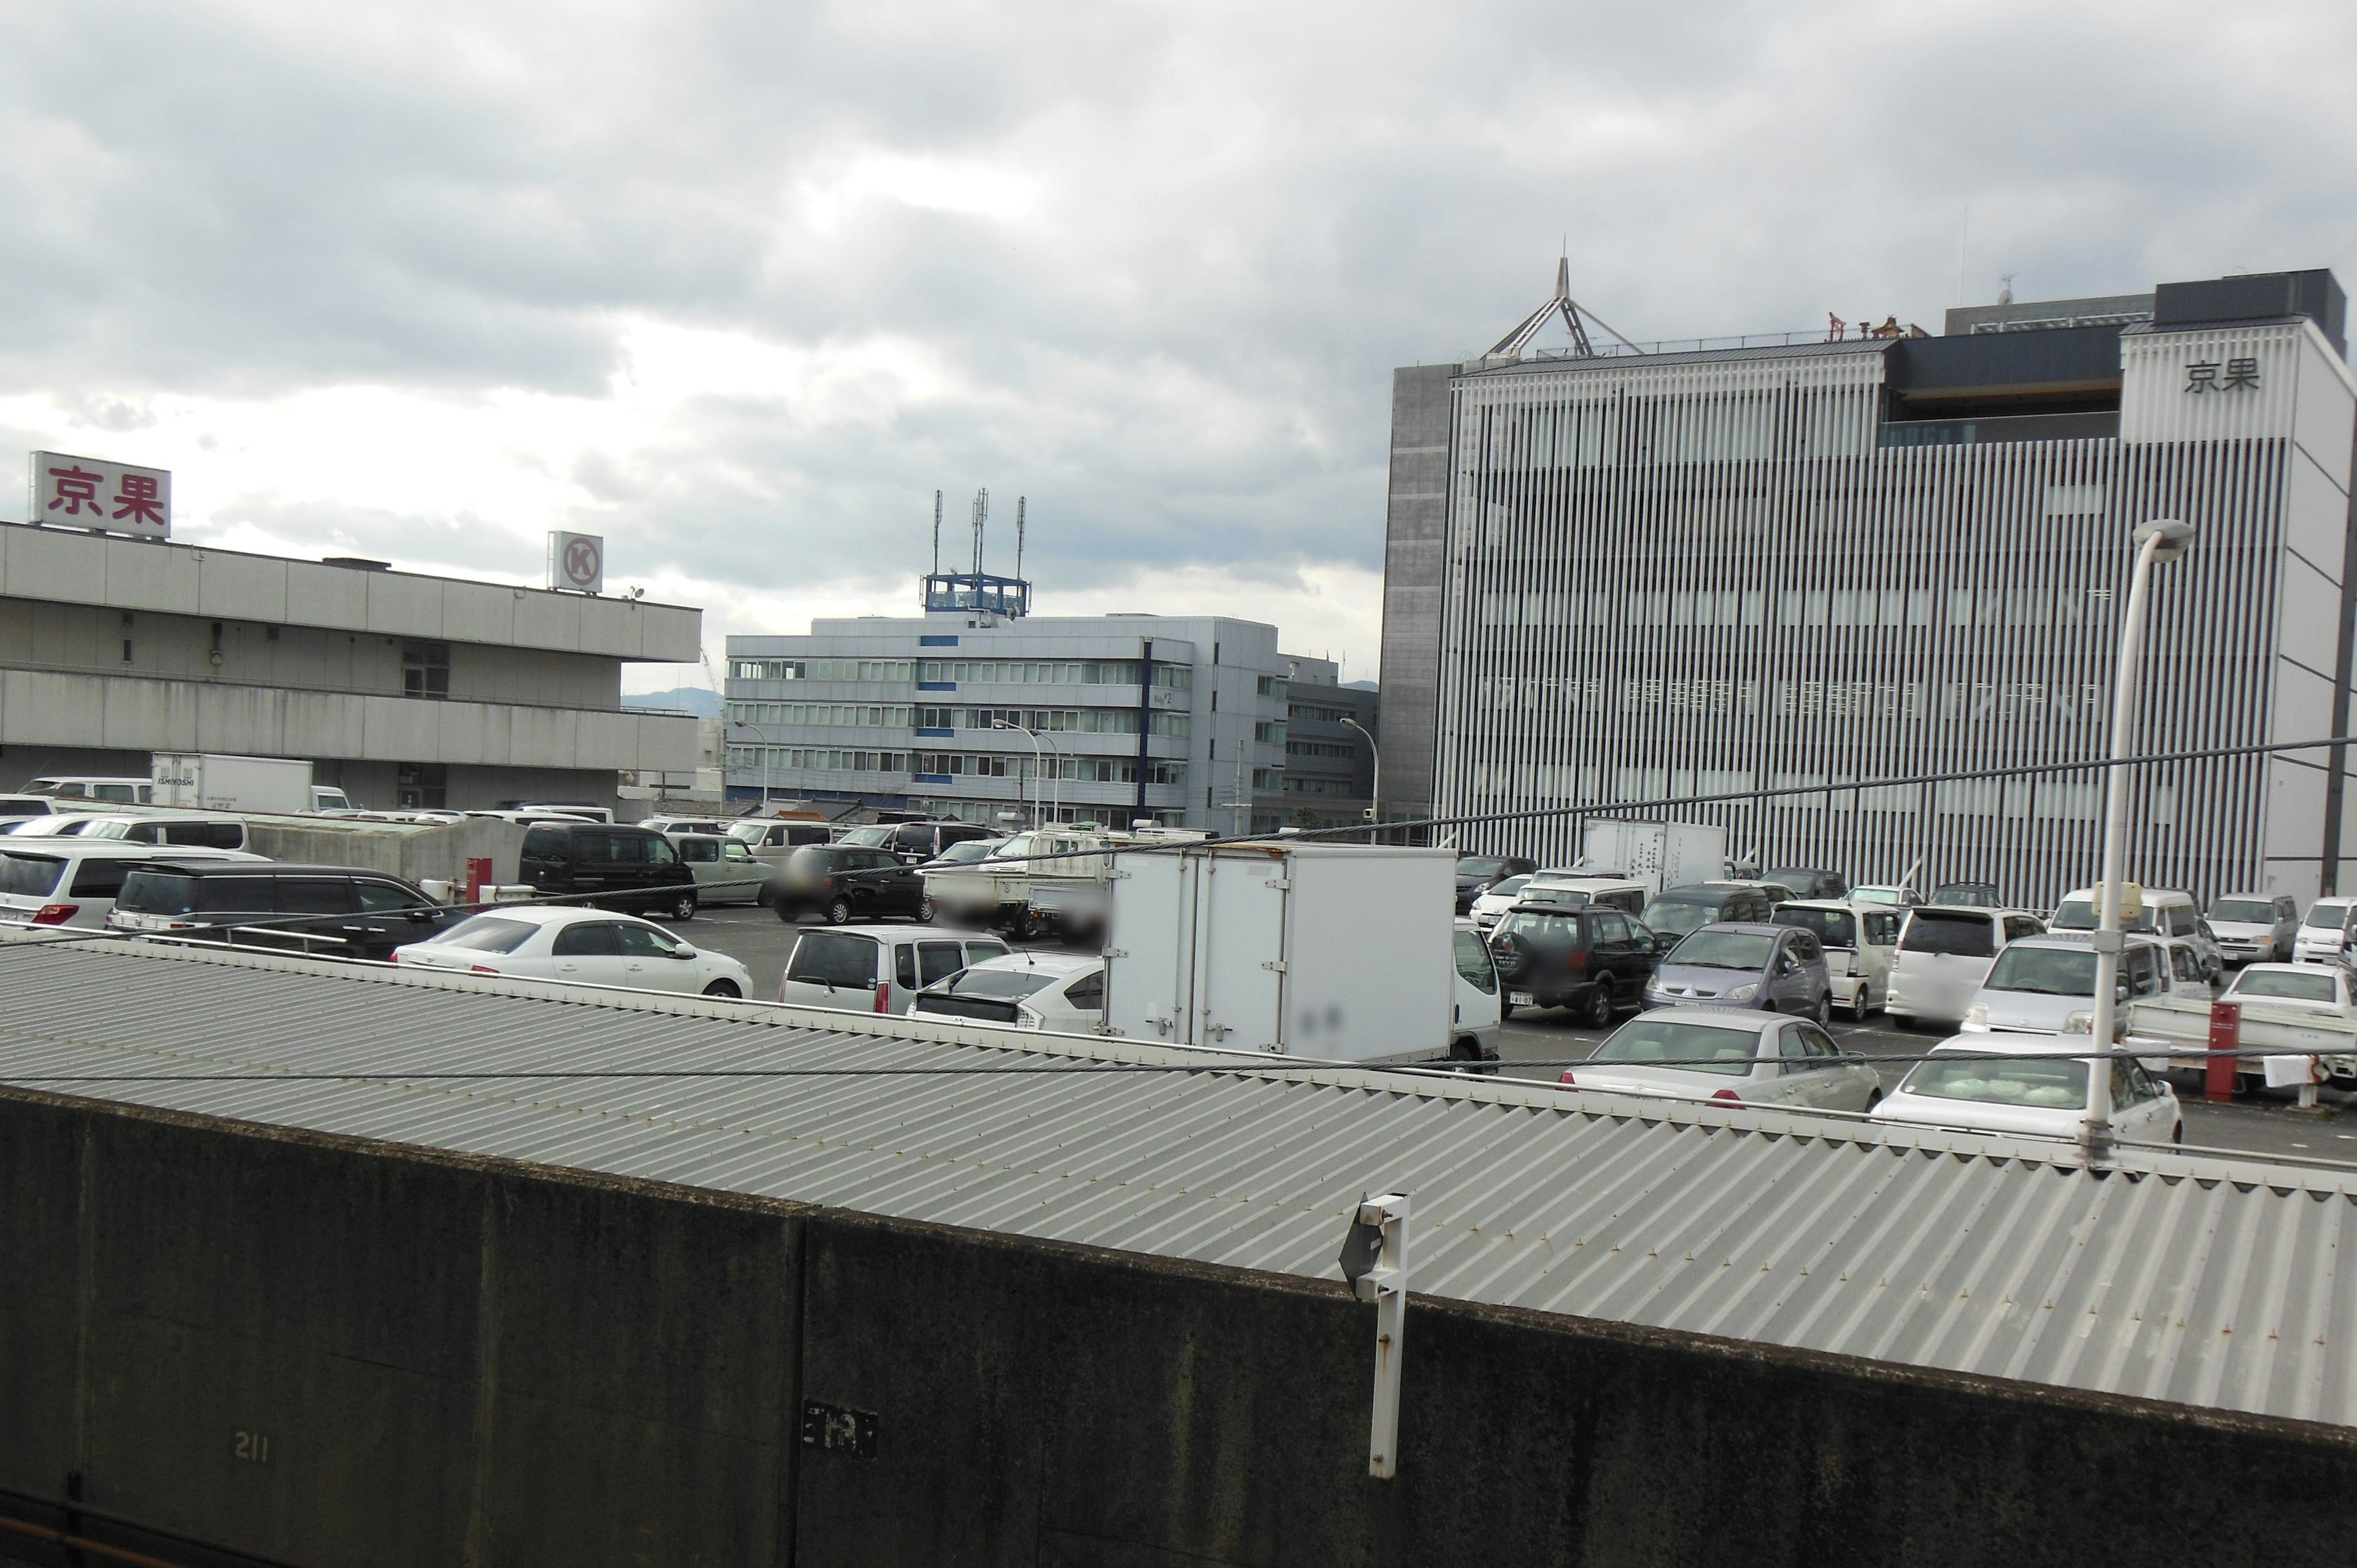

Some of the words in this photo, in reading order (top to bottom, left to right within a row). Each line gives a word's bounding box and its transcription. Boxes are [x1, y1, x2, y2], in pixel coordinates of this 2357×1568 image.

[2184, 358, 2259, 394] 京果
[48, 465, 165, 526] 京果
[571, 546, 593, 576] K
[235, 1431, 269, 1462] 211
